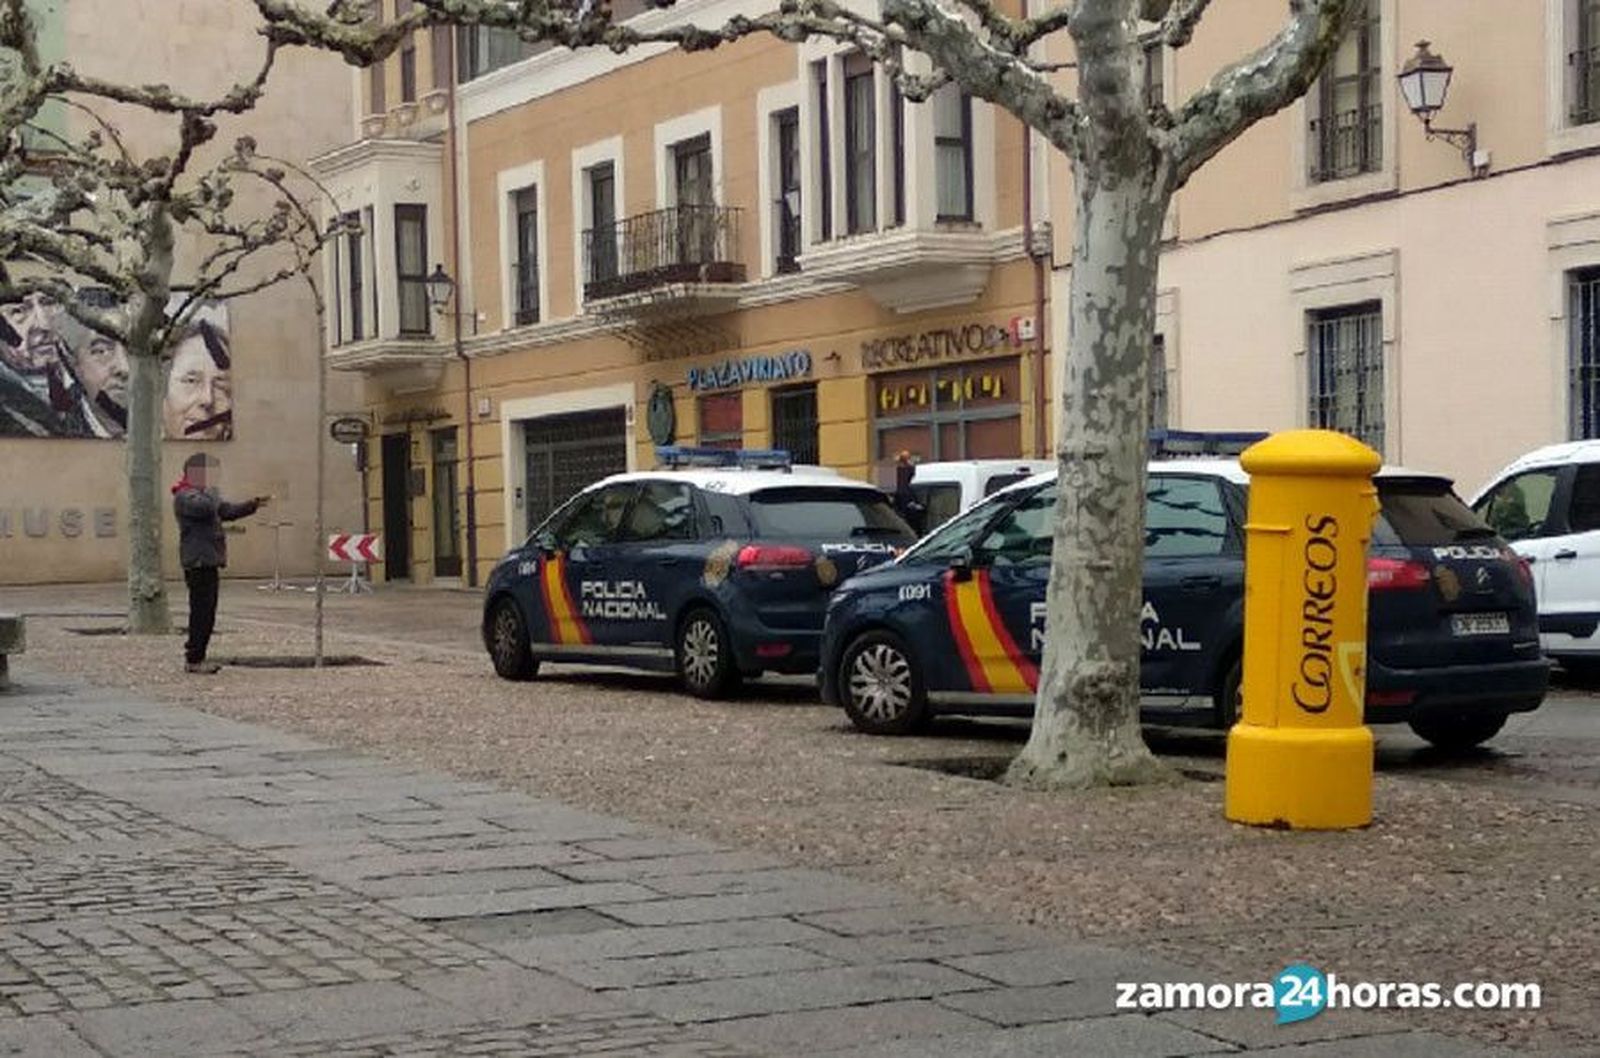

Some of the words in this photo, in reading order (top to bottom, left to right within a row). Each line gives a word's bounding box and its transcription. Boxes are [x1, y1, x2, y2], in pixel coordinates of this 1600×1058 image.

[581, 581, 646, 599] POLICIA
[582, 601, 667, 620] NACIONAL
[1292, 513, 1339, 714] CORREOS
